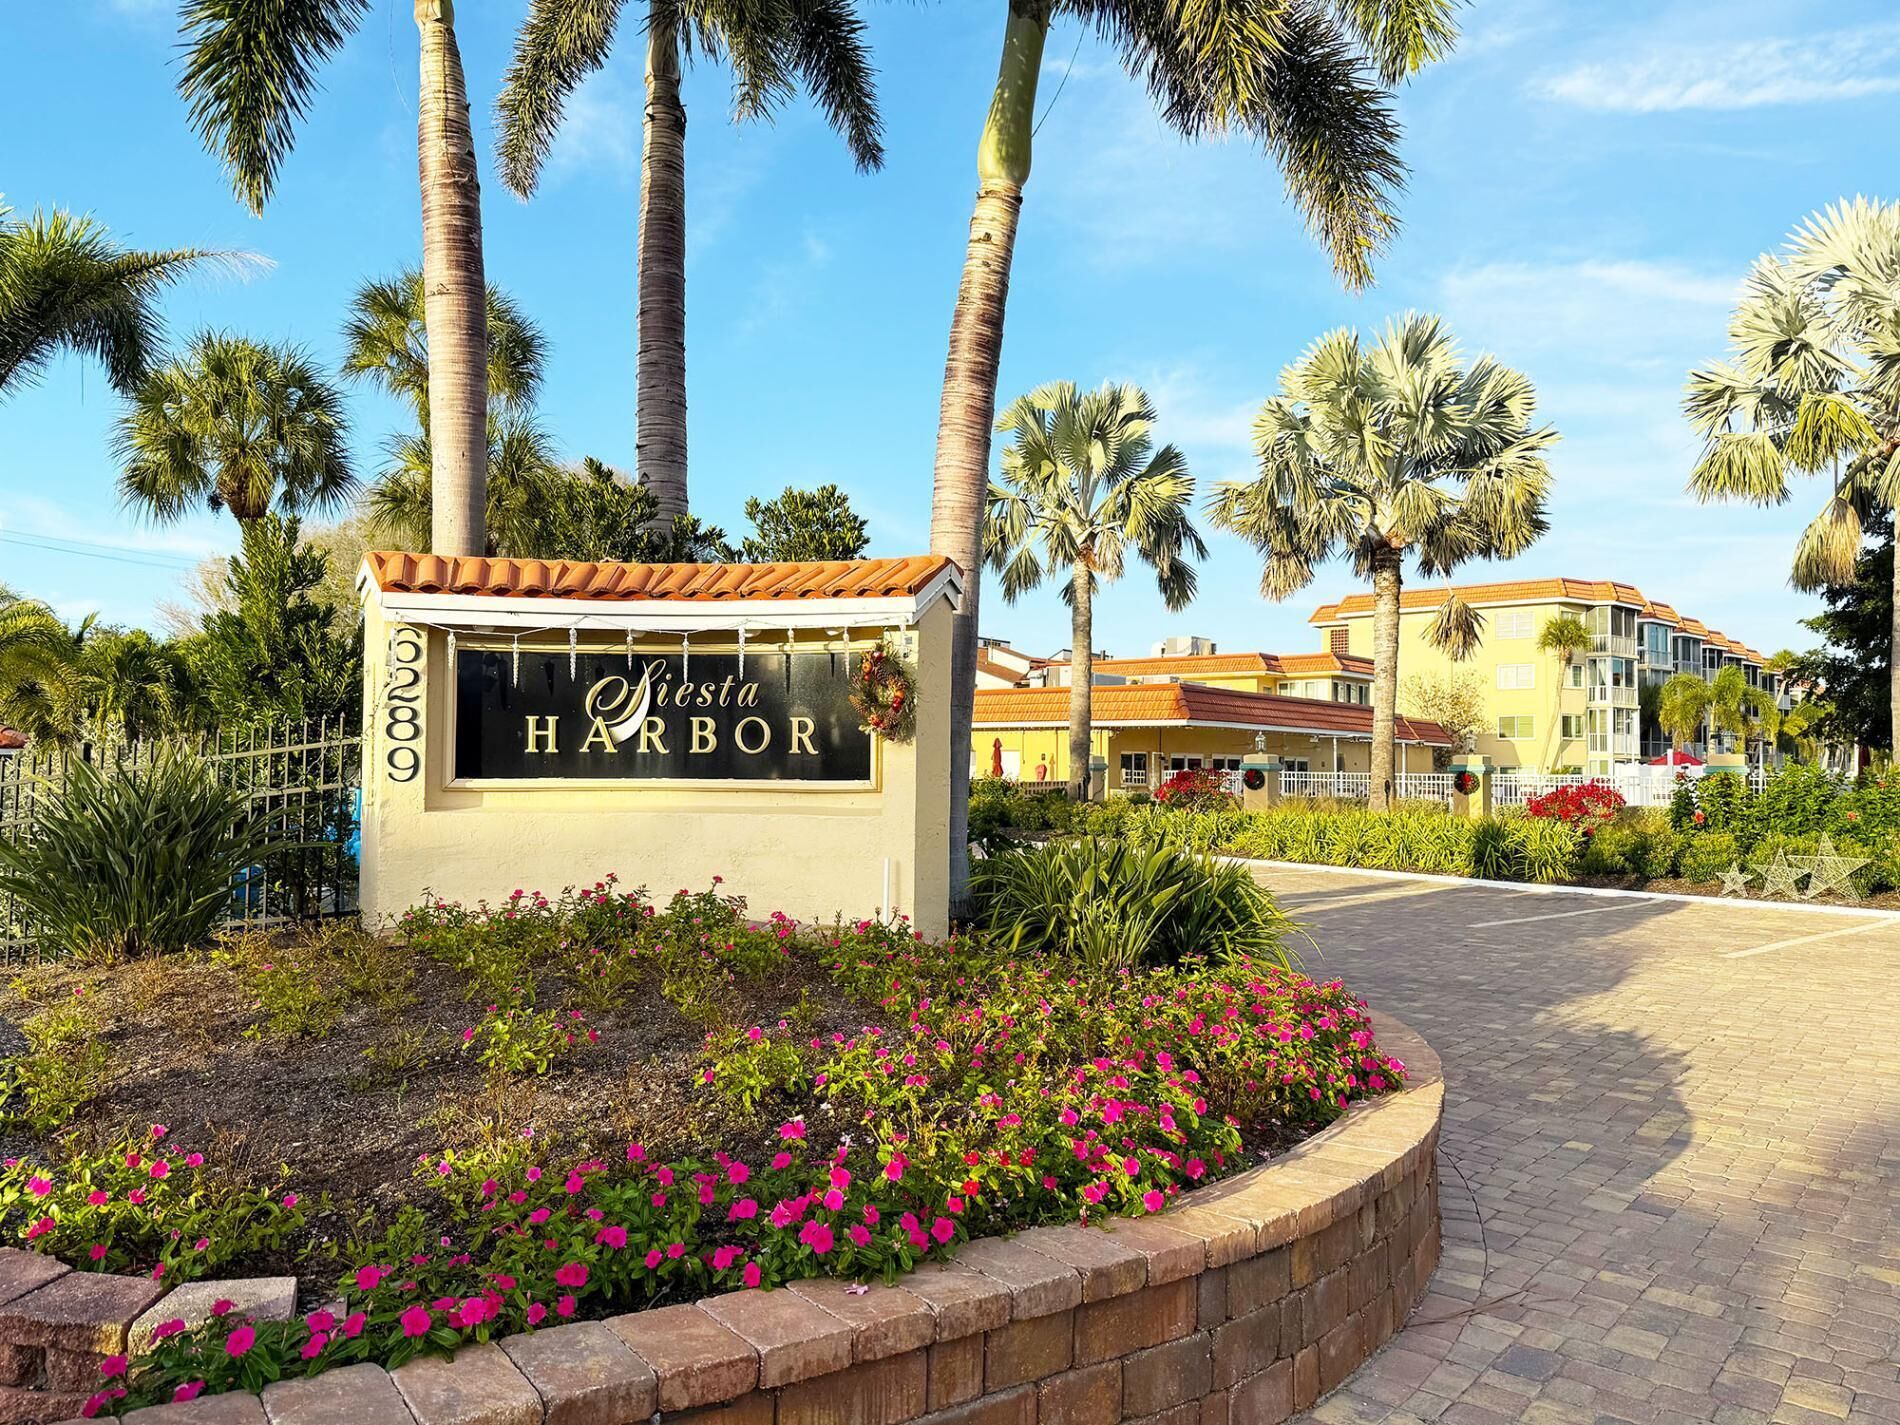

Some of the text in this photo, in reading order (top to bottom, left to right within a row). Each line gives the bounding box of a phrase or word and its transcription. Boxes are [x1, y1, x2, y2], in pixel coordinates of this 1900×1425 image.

[385, 627, 421, 783] 6289
[585, 659, 760, 726] Siesta
[524, 715, 820, 755] HARBOR
